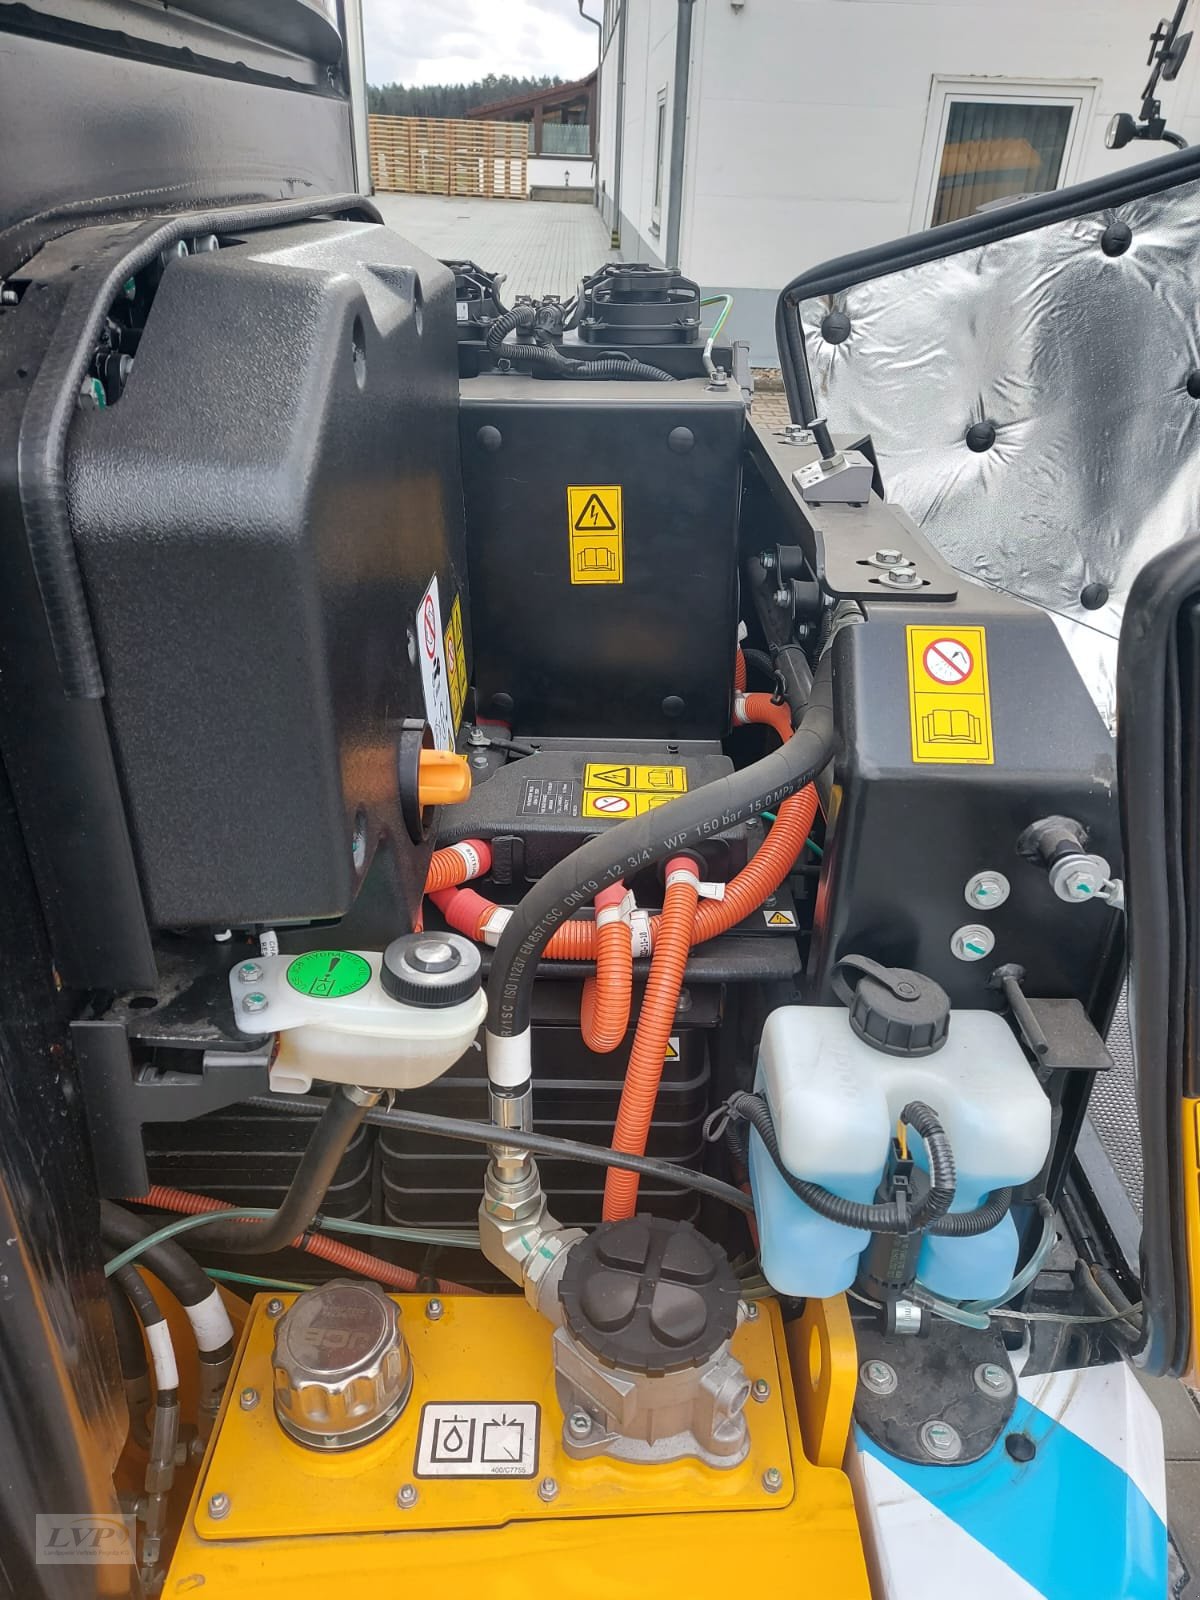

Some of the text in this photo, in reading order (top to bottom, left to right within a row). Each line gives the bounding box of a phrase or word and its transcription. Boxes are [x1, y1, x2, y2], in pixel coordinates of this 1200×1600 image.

[774, 786, 794, 801] MPa
[749, 794, 772, 813] 15.0
[722, 809, 742, 826] bar
[695, 818, 719, 837] 150
[664, 832, 688, 849] WP
[603, 864, 625, 881] -12
[582, 880, 599, 894] 19
[563, 889, 582, 907] DN
[542, 908, 563, 926] 1SC
[531, 925, 546, 943] 857
[520, 942, 533, 956] EN
[508, 957, 527, 982] 11237
[504, 984, 519, 999] ISO
